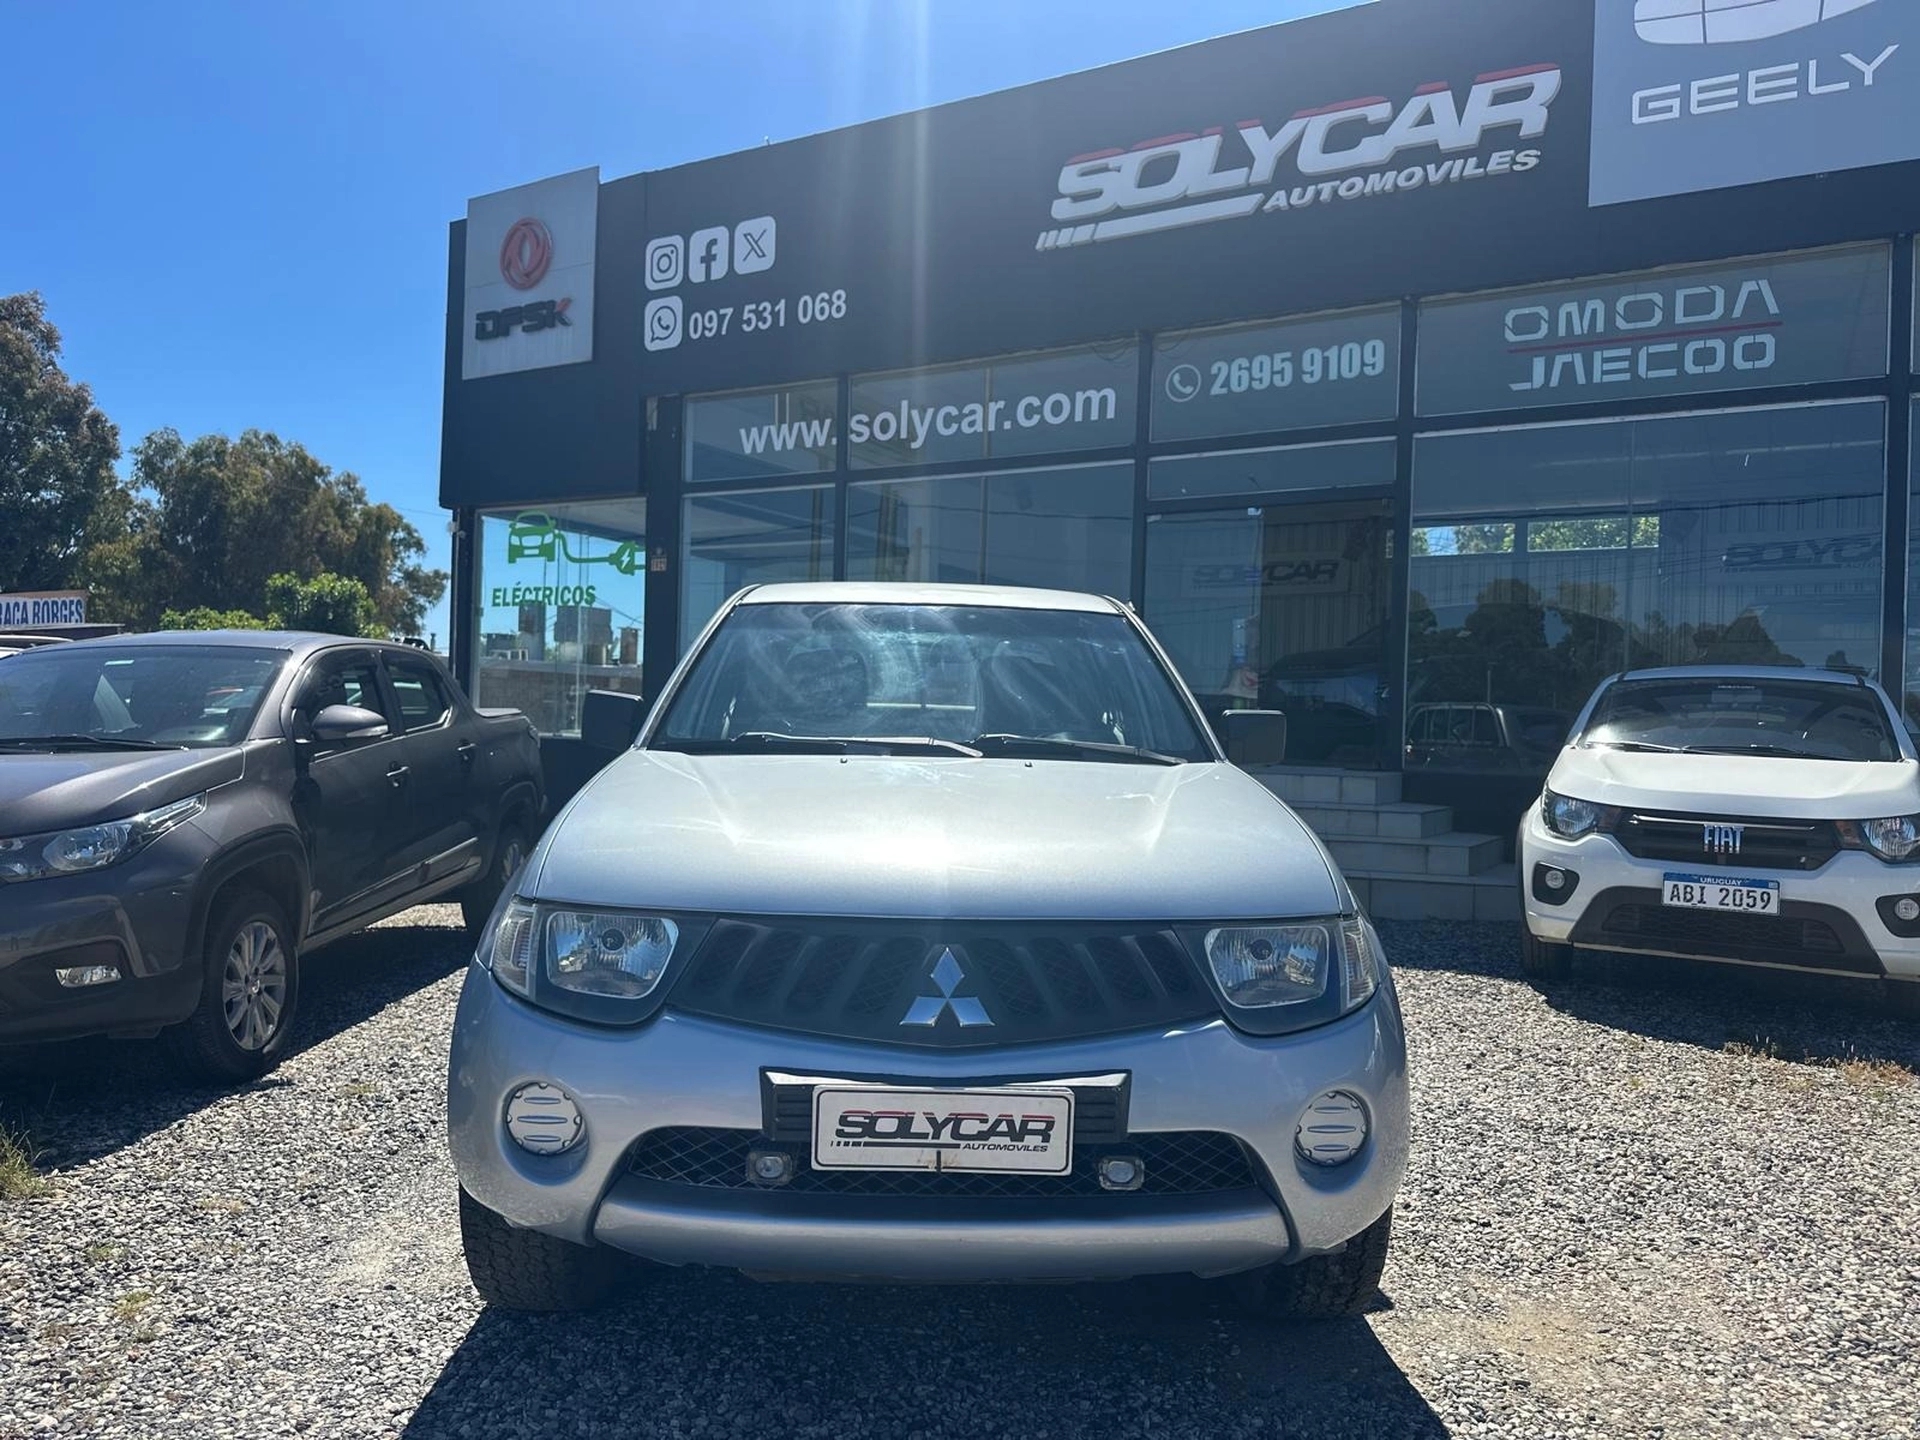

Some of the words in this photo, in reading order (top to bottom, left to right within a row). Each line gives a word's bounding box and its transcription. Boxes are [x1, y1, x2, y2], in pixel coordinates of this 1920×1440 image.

[1632, 44, 1899, 125] GEELY
[1051, 63, 1561, 221] SOLYCAR
[1263, 148, 1541, 213] AUTOMOVILES
[475, 298, 572, 340] DFSK
[690, 308, 733, 340] 097
[741, 299, 788, 333] 531
[798, 289, 847, 325] 068
[1504, 279, 1780, 343] OMODA
[1210, 352, 1293, 396] 2695
[1302, 338, 1386, 384] 9109
[1508, 334, 1776, 391] JAECOO
[33, 599, 83, 624] BORGES
[492, 581, 596, 607] ELÉCTRICOS
[1703, 824, 1744, 853] FIAT
[1670, 883, 1706, 905] ABI
[1719, 887, 1771, 910] 2059
[1700, 876, 1742, 886] URUGUAY
[835, 1110, 1056, 1144] SOLYCAR
[962, 1143, 1048, 1153] AUTOMOVILES
